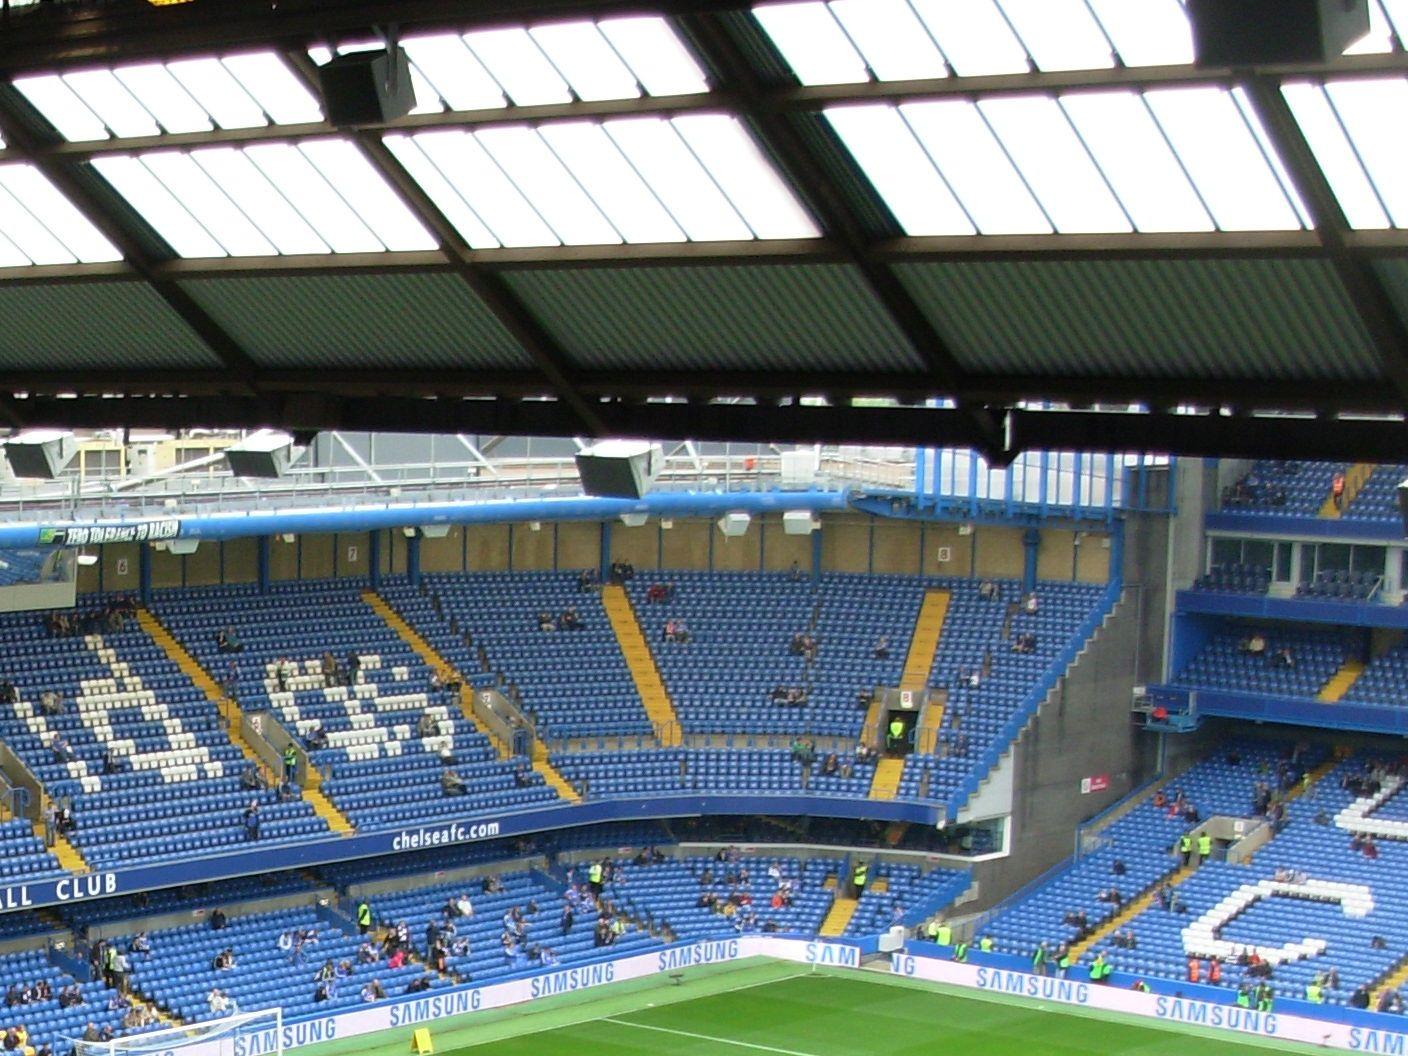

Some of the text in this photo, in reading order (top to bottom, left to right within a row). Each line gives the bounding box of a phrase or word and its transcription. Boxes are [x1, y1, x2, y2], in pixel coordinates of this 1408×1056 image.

[393, 822, 499, 850] chelseafc.com
[56, 873, 117, 900] CLUB
[658, 940, 738, 971] SAMSUNG
[532, 963, 614, 997] SAMSUNG
[976, 968, 1088, 1003] SAMSUNG
[390, 990, 481, 1026] SAMSUNG
[1155, 996, 1278, 1035] SAMSUNG
